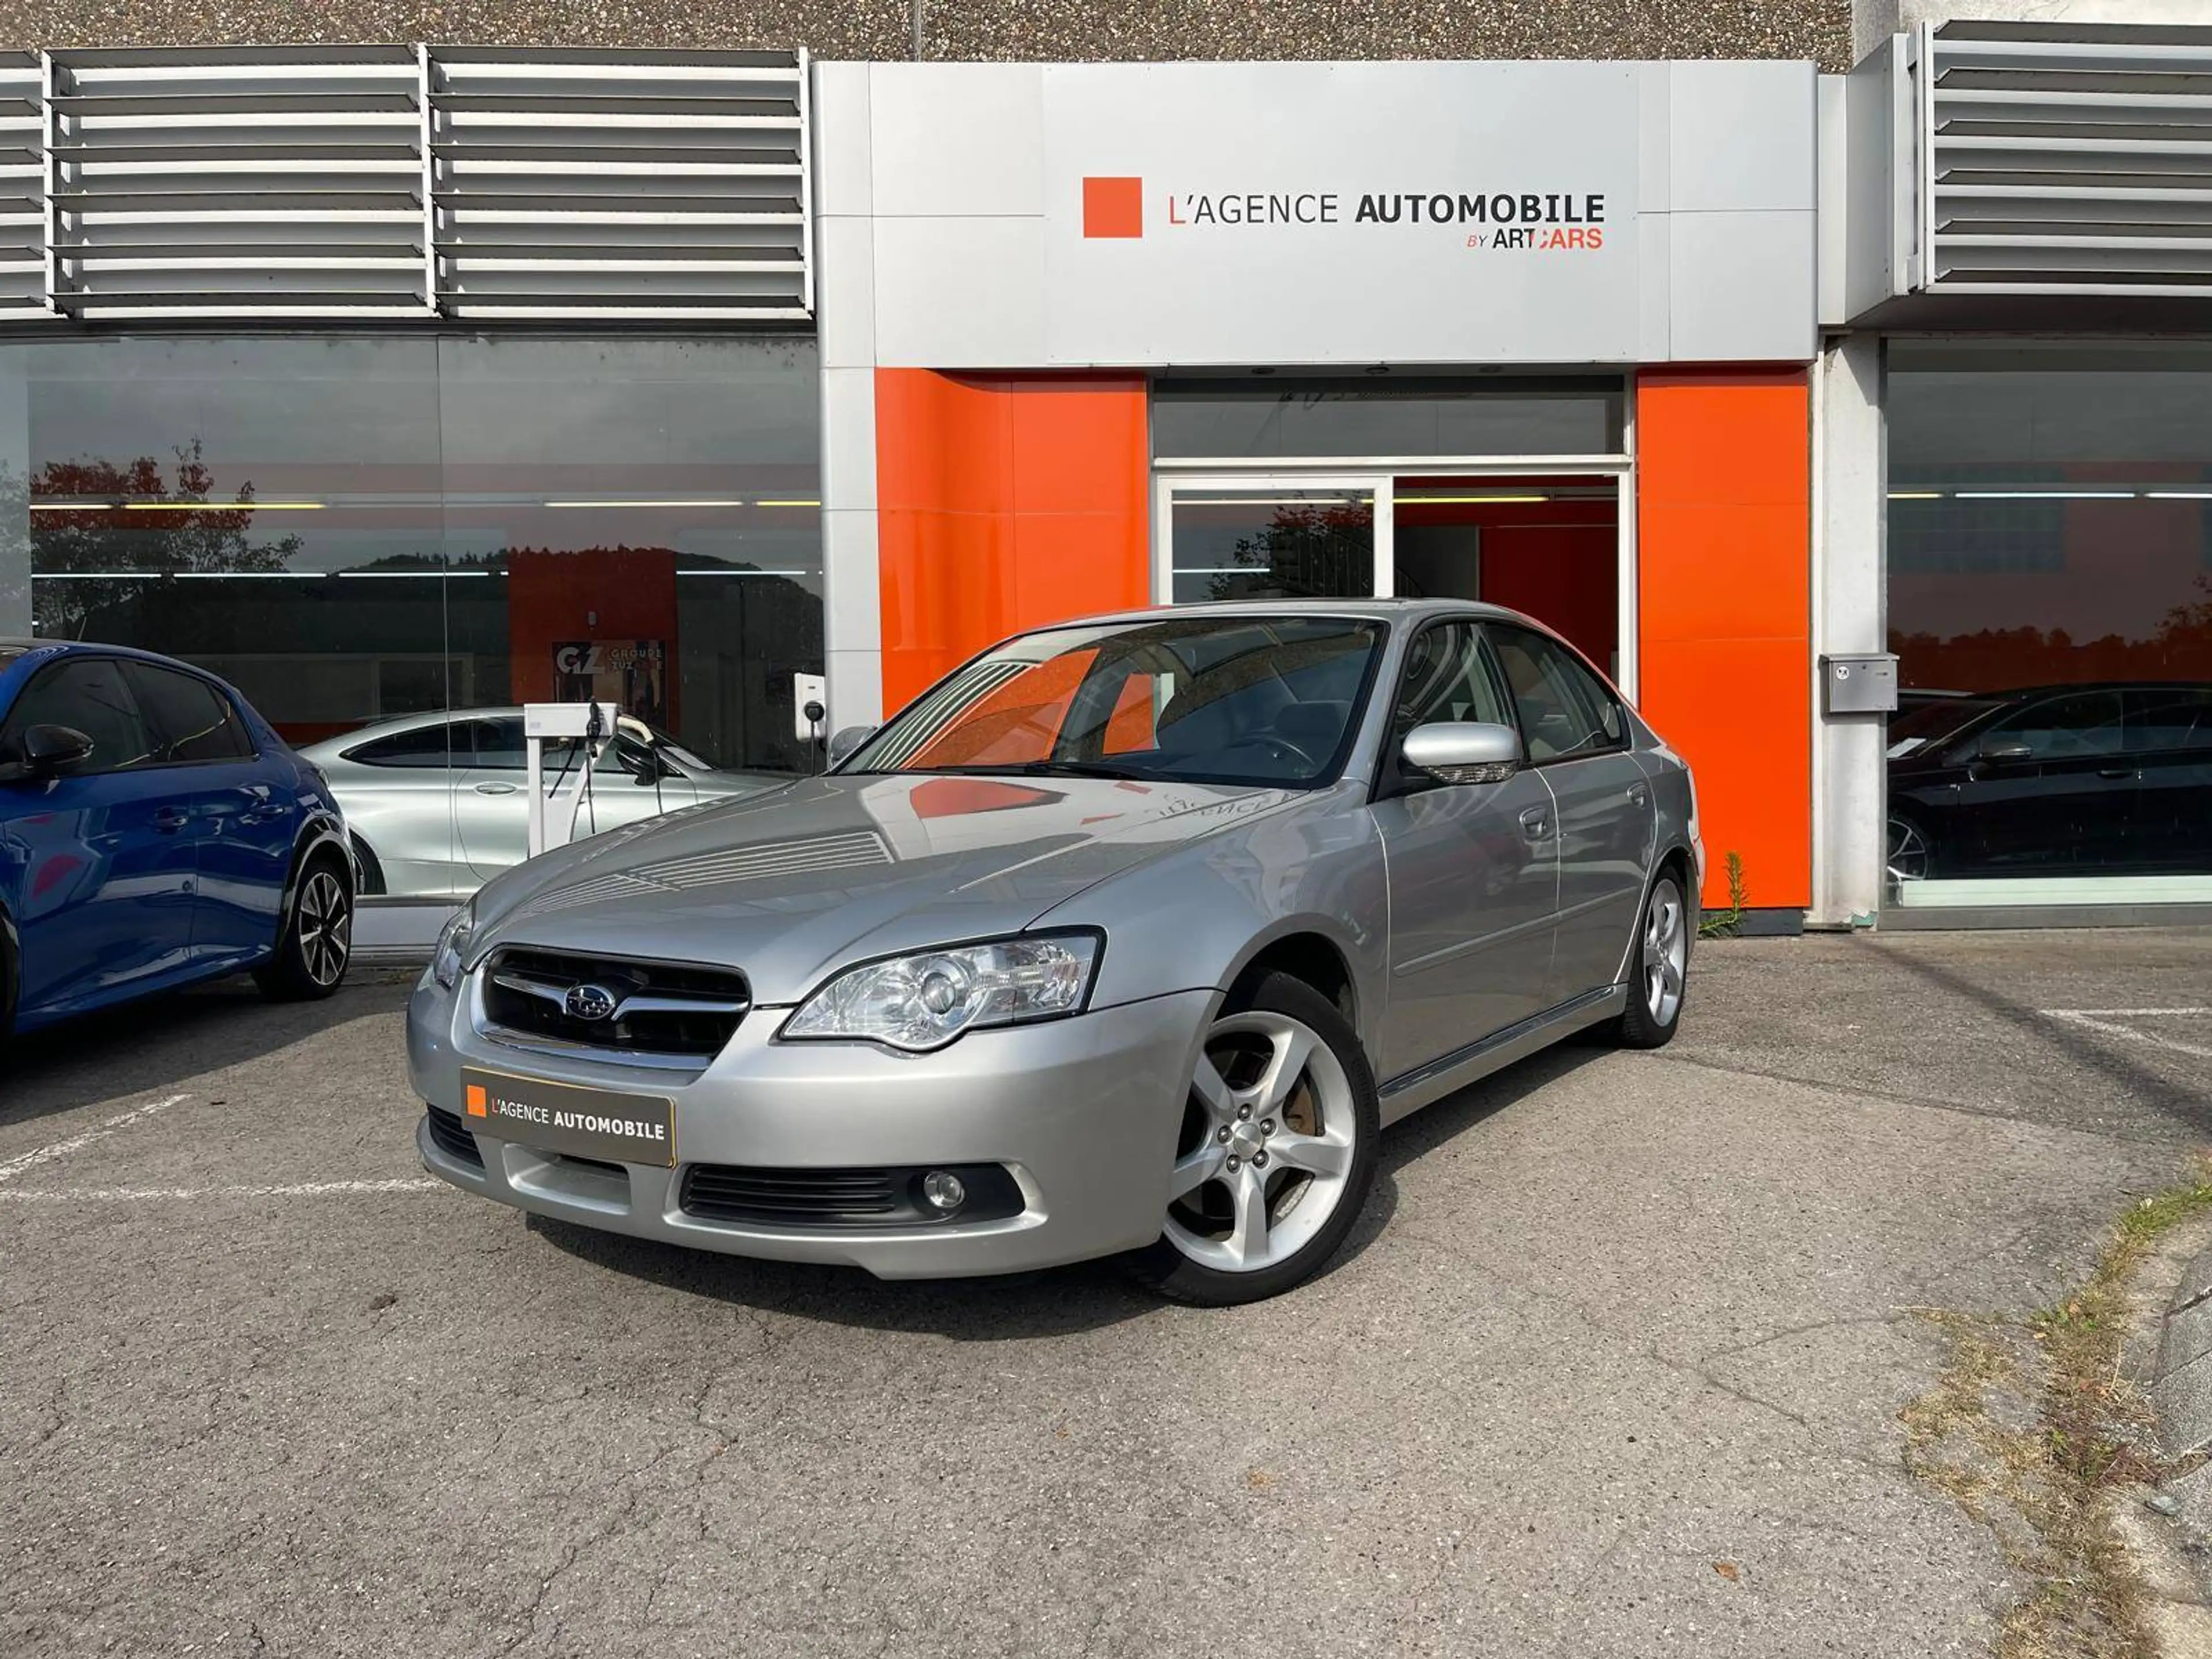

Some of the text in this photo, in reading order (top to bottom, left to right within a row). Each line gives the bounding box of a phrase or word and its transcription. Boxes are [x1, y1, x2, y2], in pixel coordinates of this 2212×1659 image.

[1169, 194, 1604, 224] L'AGENCE AUTOMOBILE
[1467, 234, 1487, 248] BY
[492, 1097, 665, 1141] L'AGENCE AUTOMOBILE
